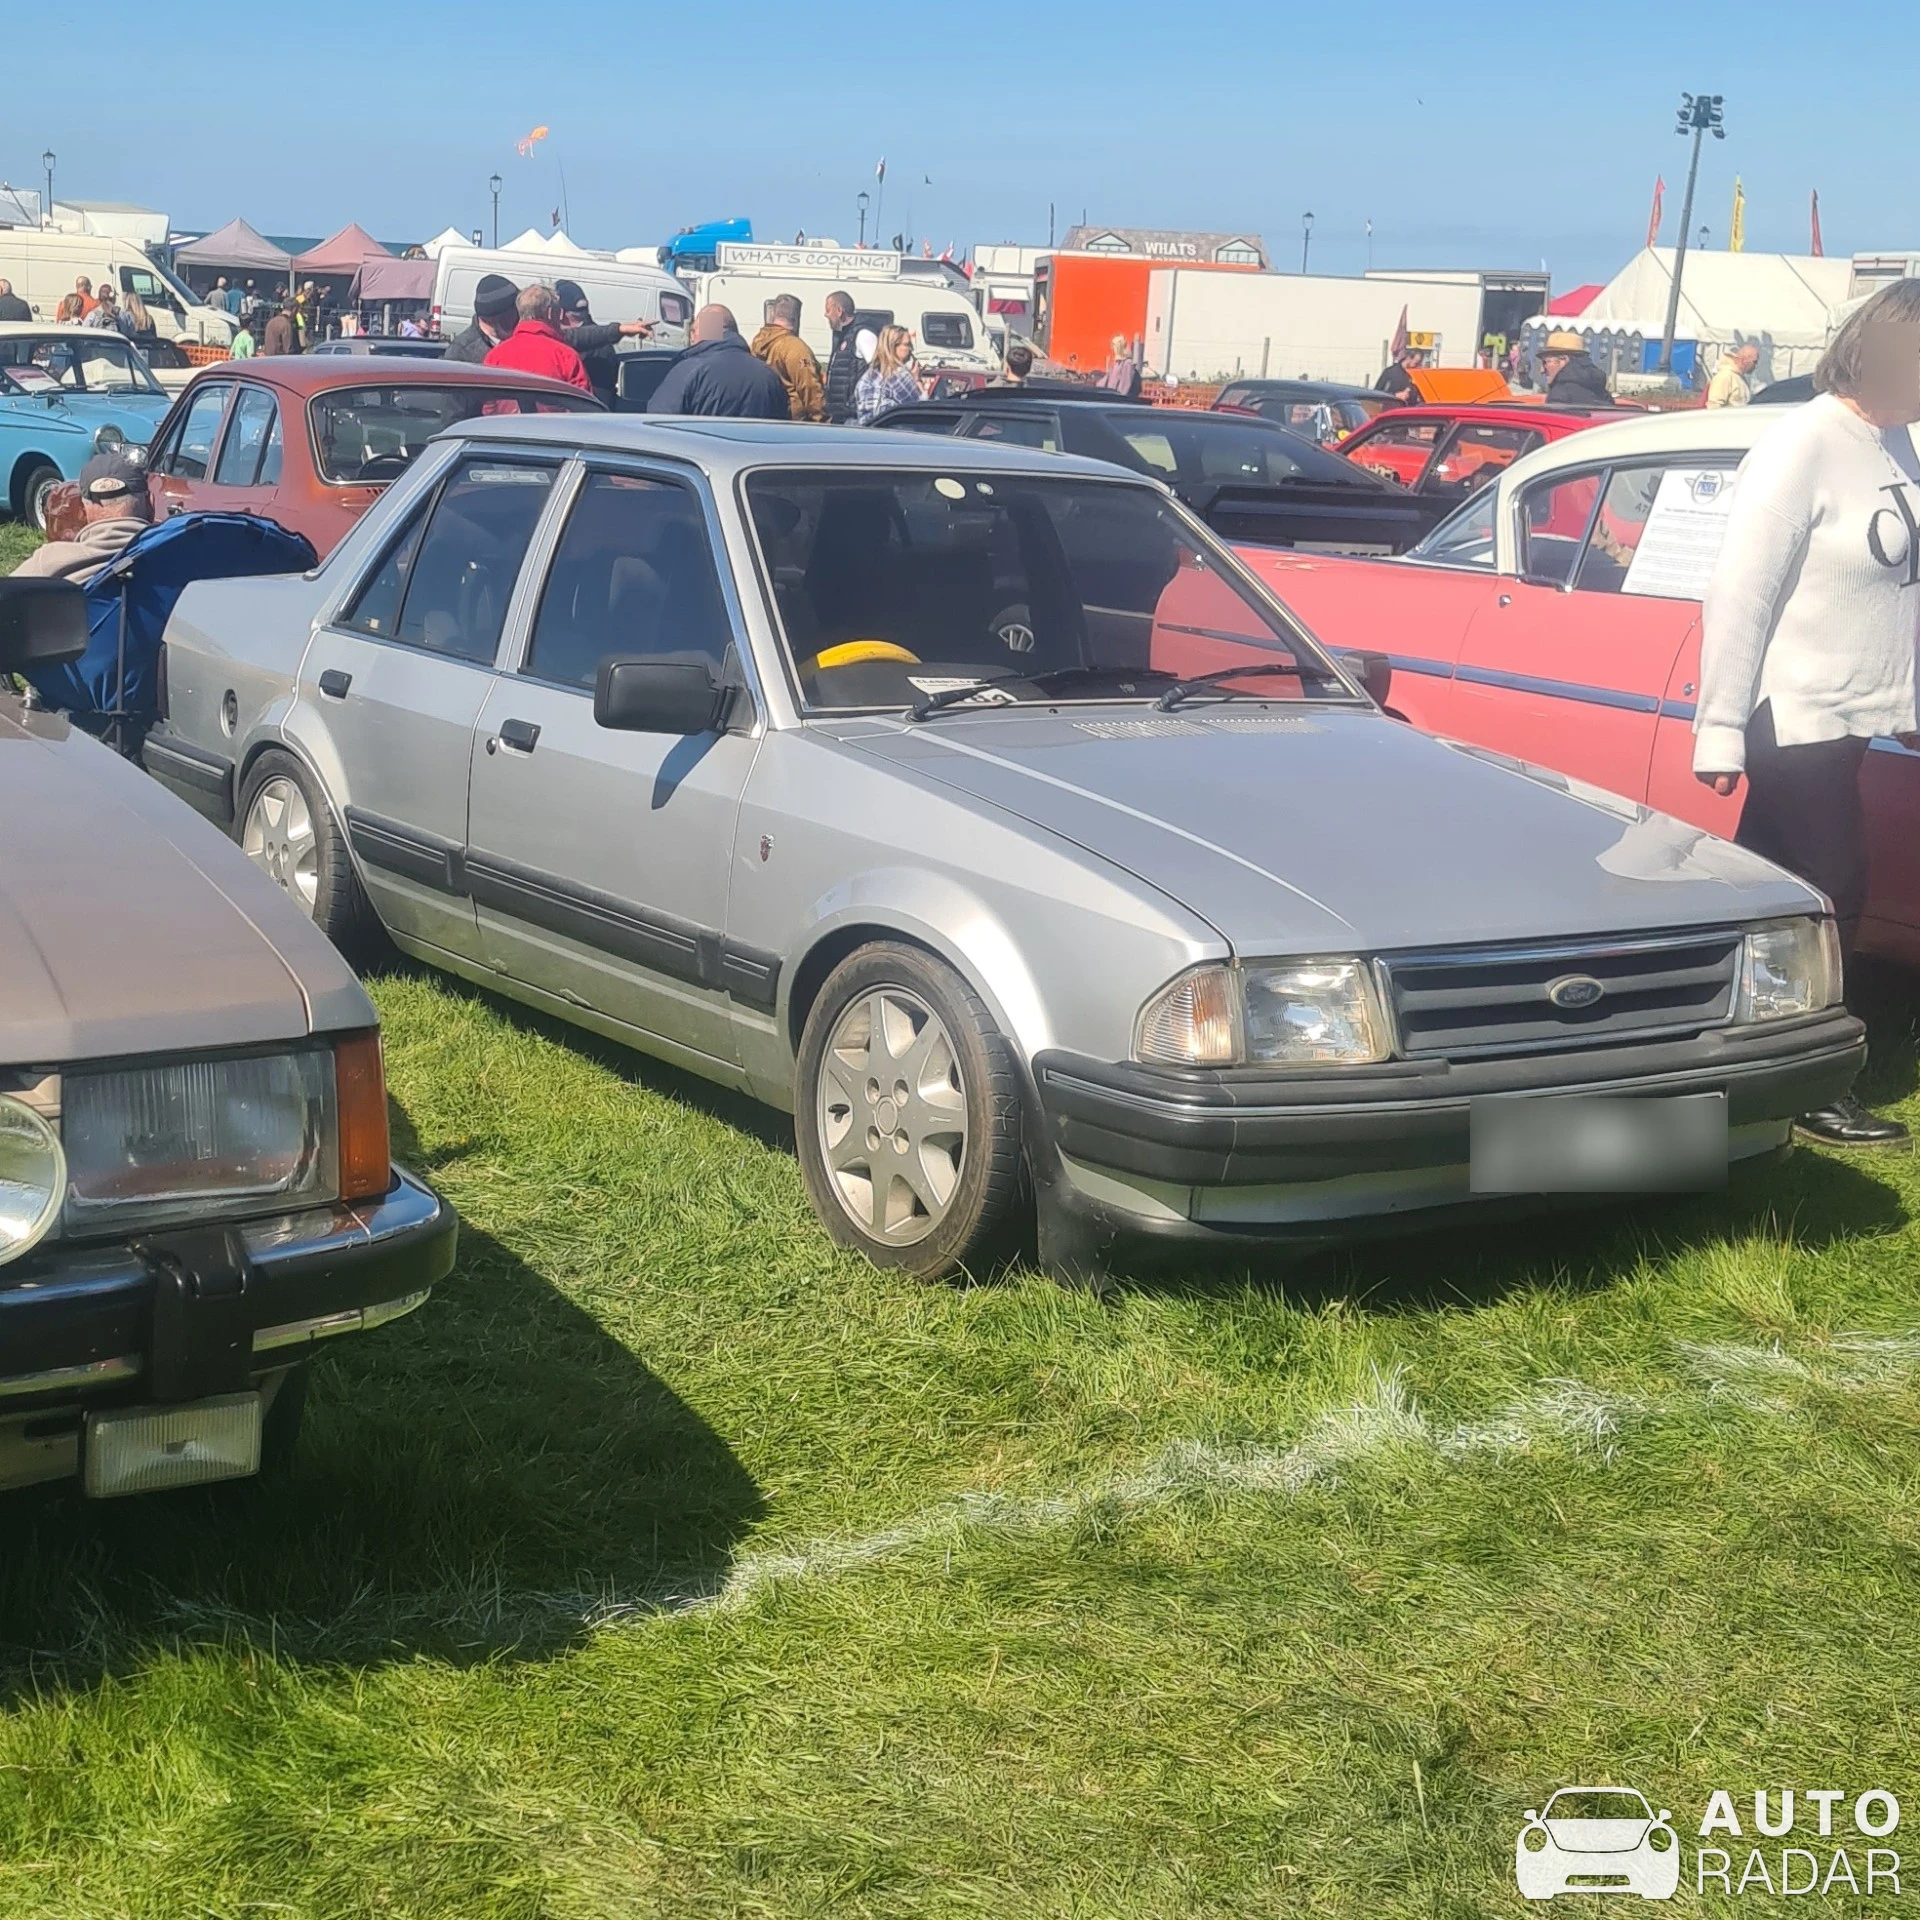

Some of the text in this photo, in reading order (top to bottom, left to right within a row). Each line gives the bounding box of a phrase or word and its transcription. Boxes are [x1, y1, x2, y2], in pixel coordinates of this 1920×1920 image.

[1145, 241, 1197, 256] WHAT'S
[731, 250, 892, 268] WHAT'S COOKING?
